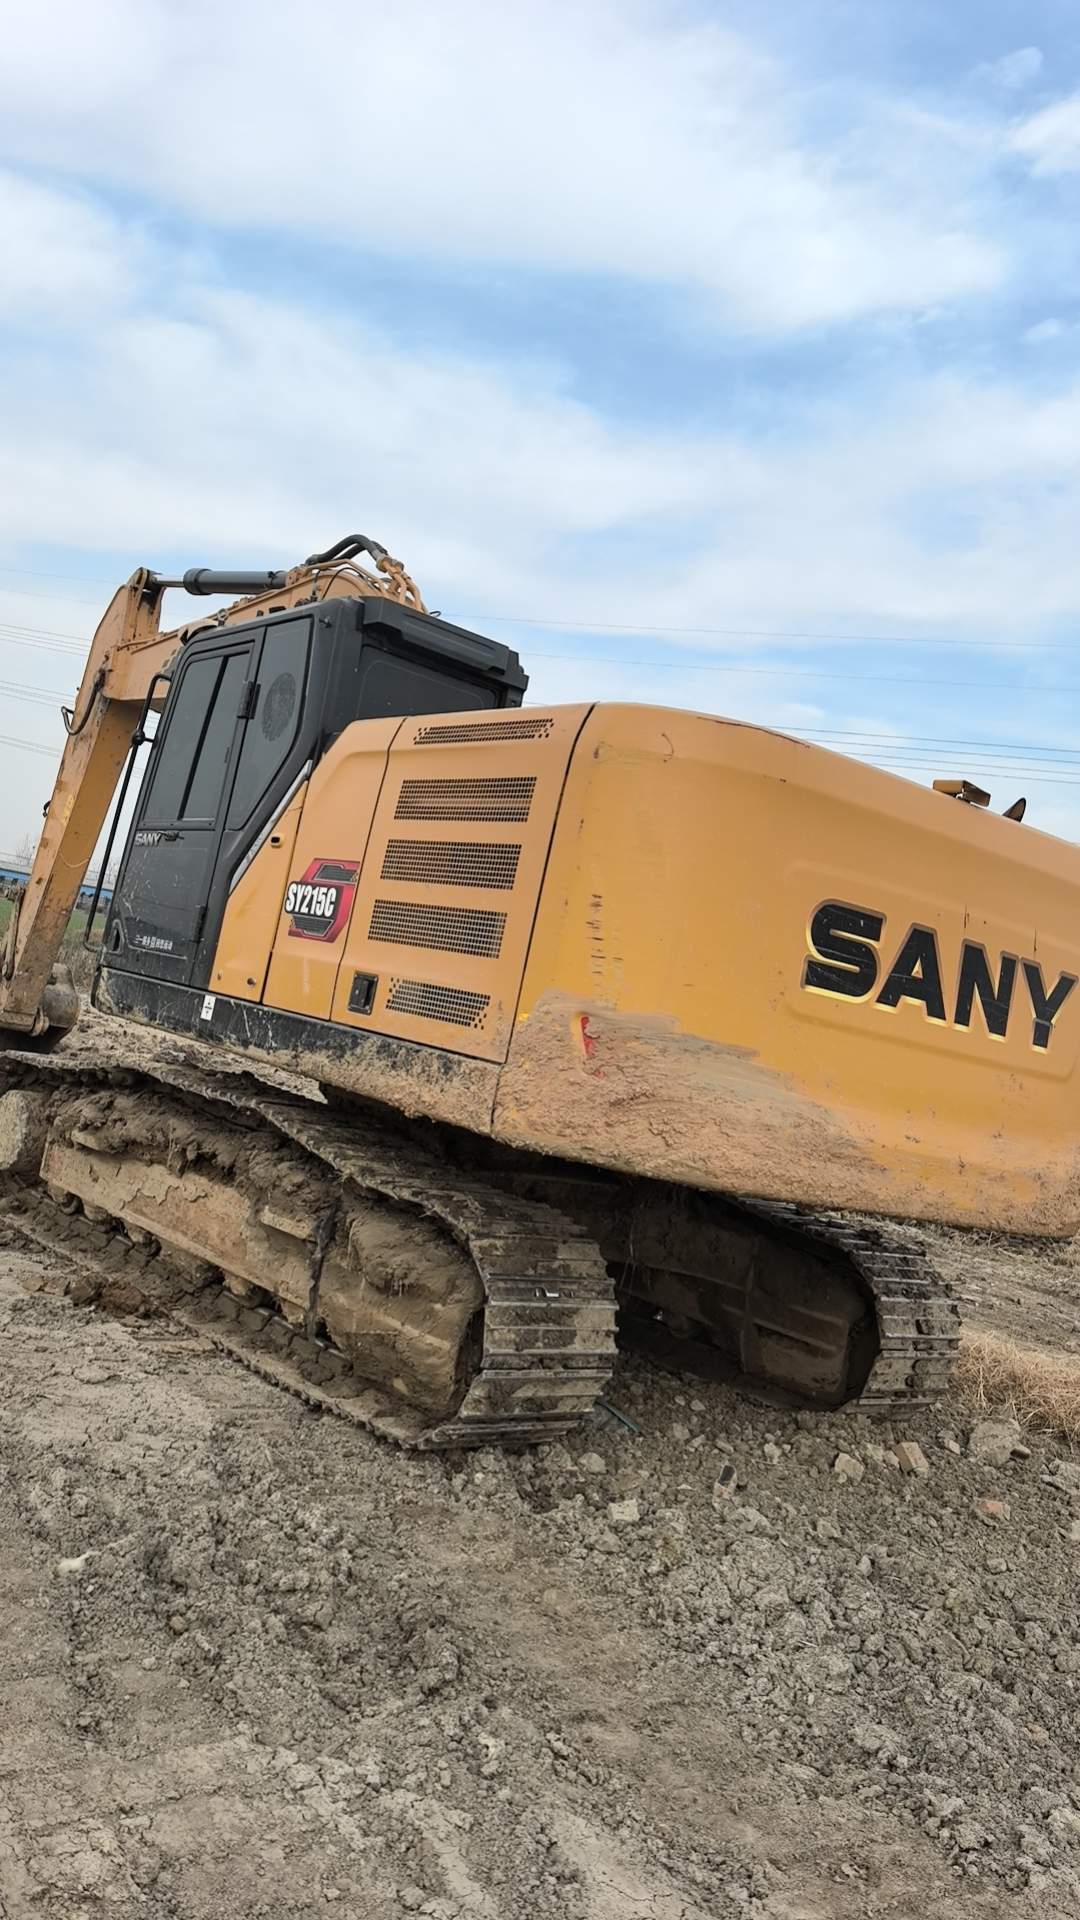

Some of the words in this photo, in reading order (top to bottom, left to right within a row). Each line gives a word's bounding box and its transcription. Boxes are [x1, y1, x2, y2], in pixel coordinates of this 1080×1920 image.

[135, 833, 161, 846] SANY
[285, 882, 337, 917] SY215C
[802, 900, 1079, 1053] SANY
